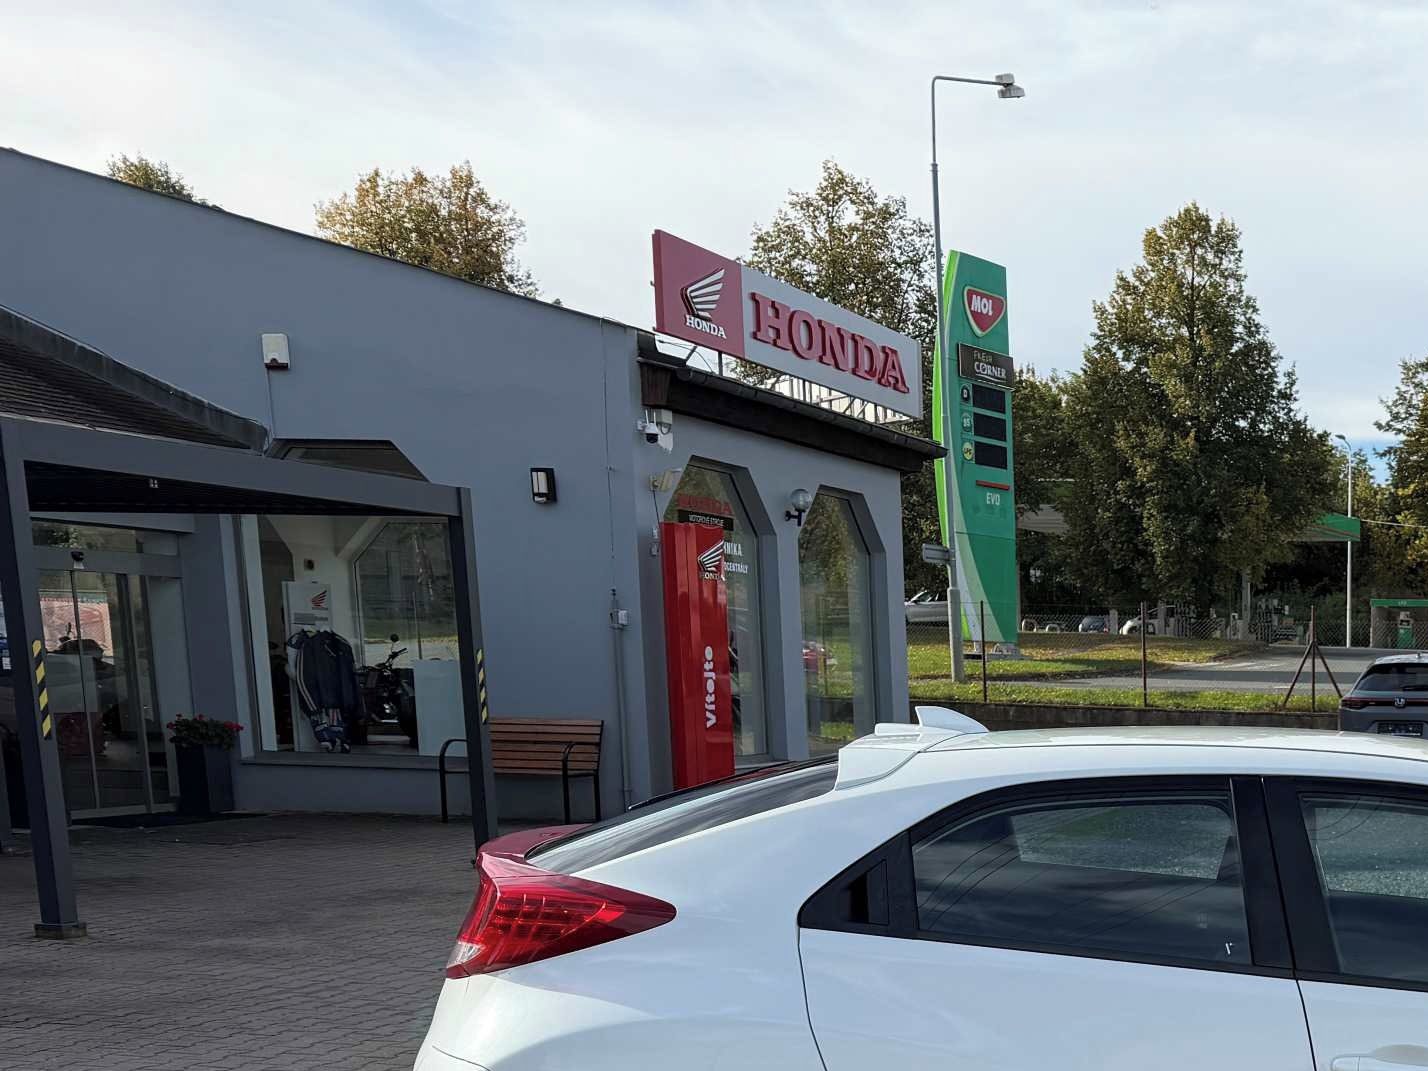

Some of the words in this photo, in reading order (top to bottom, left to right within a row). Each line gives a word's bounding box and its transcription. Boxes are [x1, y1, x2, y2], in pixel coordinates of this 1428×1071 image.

[971, 294, 993, 316] MOL
[685, 315, 727, 339] HONDA
[750, 292, 910, 394] HONDA
[974, 361, 1007, 378] CORNER
[986, 492, 1001, 506] EVO
